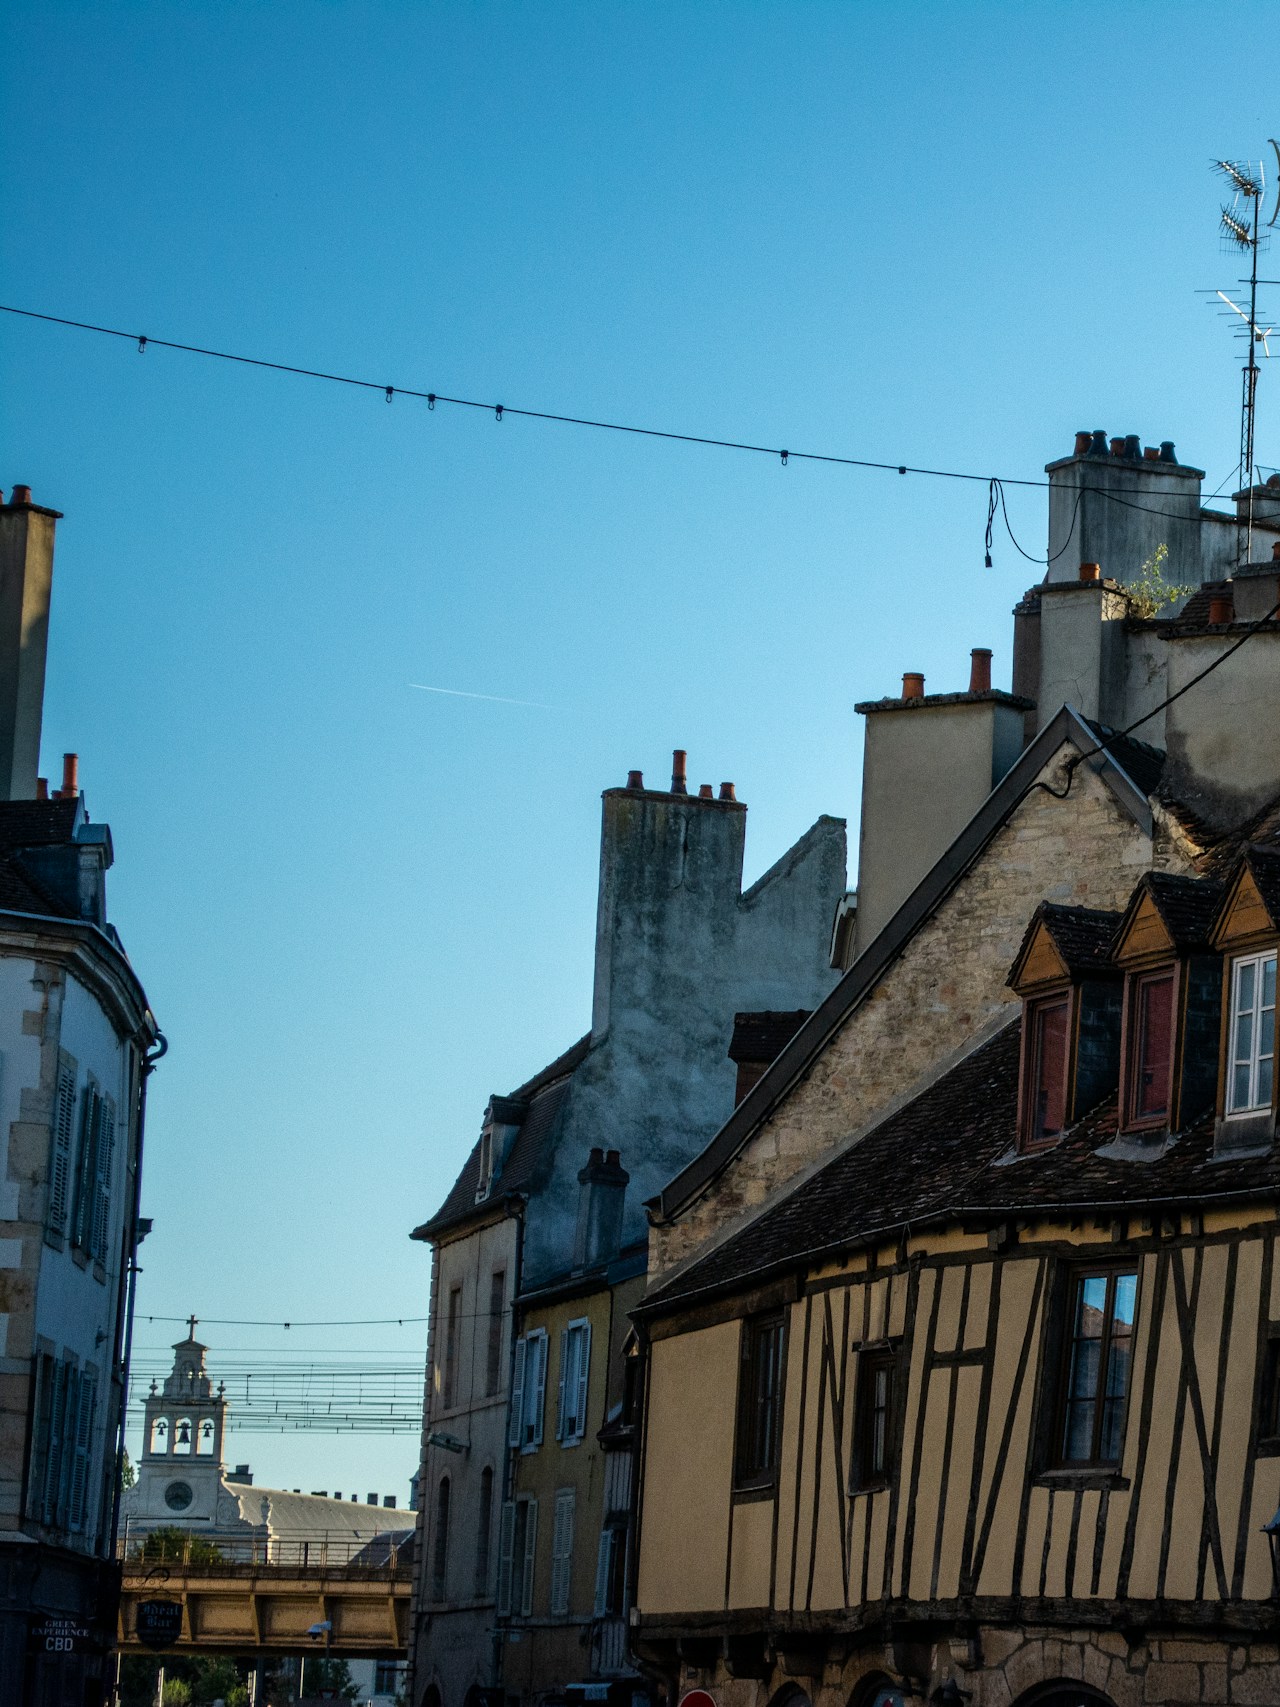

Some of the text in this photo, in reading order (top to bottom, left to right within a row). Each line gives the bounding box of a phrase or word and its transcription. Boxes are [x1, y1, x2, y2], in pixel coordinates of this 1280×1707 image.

[45, 1620, 77, 1628] GREEN
[31, 1627, 90, 1637] EXPERIENCE
[45, 1636, 74, 1652] CBD
